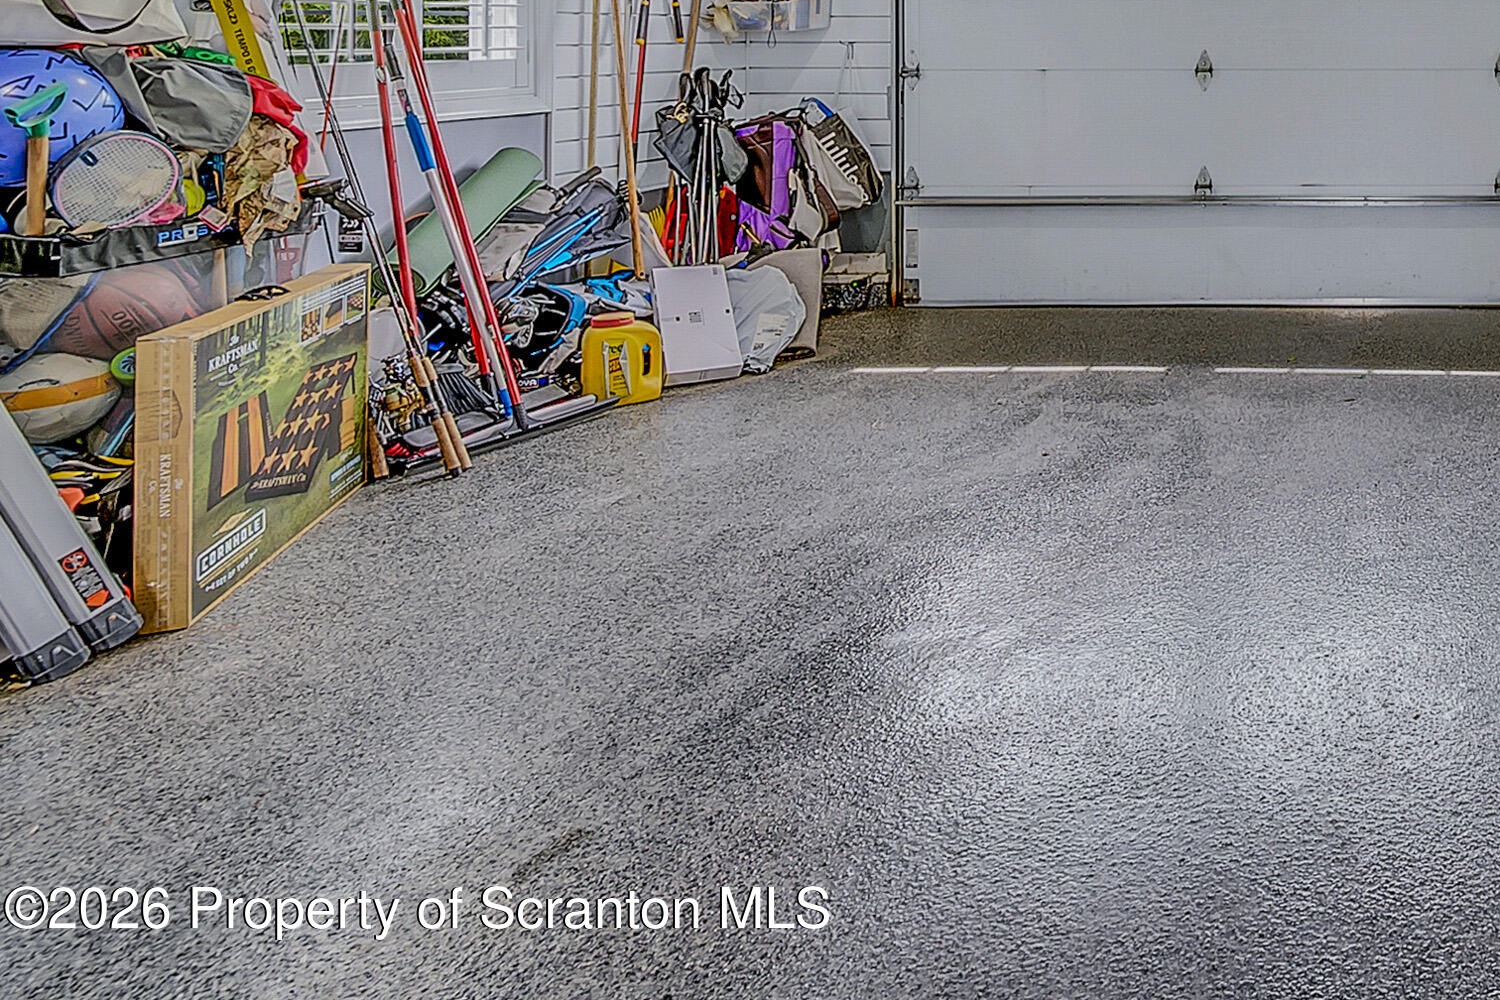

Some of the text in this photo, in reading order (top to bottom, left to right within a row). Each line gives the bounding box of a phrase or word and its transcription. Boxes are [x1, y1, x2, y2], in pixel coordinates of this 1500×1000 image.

[233, 28, 251, 58] TEMPO
[208, 338, 259, 373] KRAFTSMAN
[159, 454, 171, 518] KRAFTSMAN
[201, 518, 262, 572] CORNHOLE
